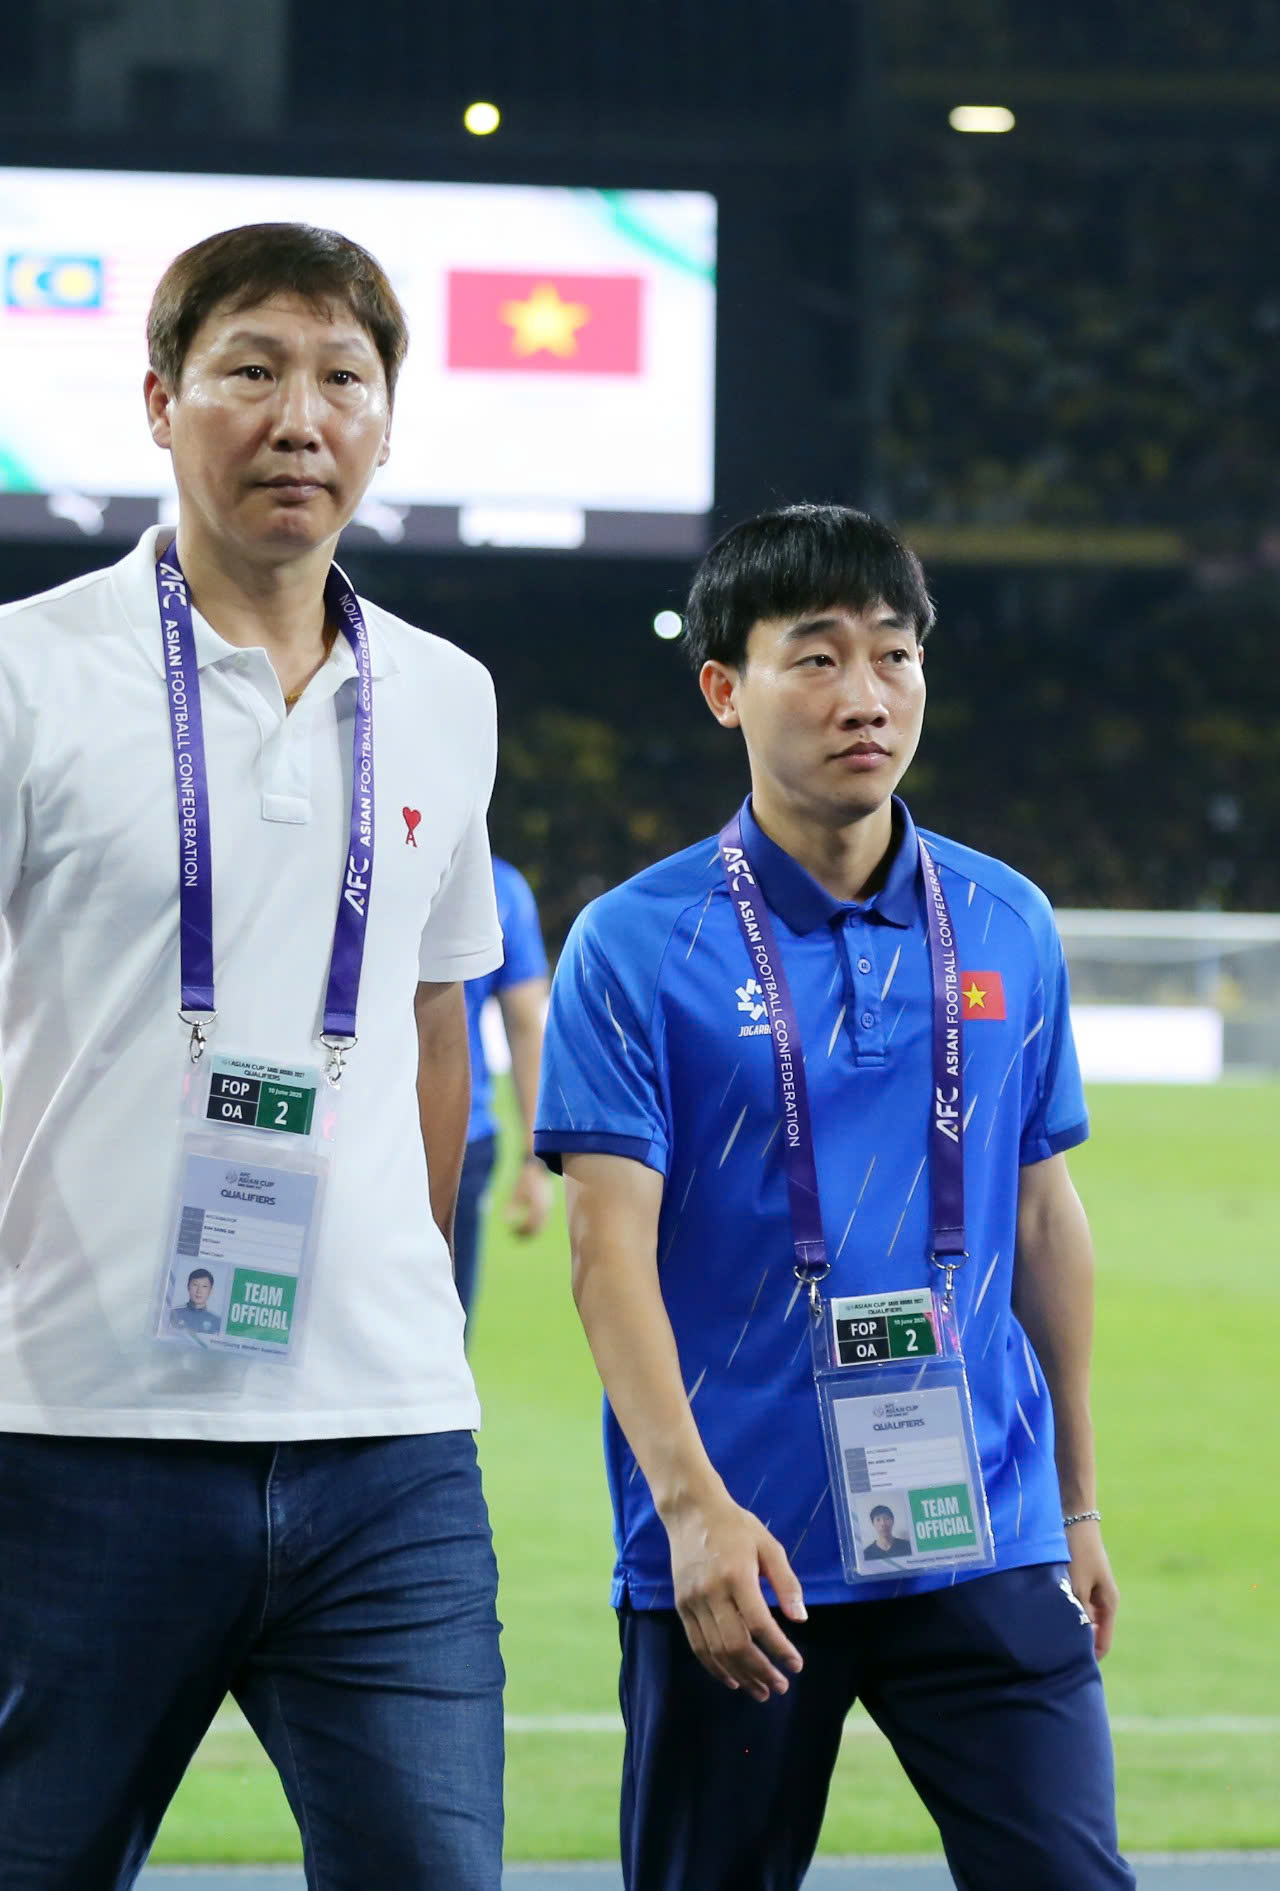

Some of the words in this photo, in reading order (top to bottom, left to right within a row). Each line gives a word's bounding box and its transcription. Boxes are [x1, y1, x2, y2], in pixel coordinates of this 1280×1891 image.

[160, 562, 188, 609] AFC
[165, 620, 182, 667] ASIAN
[339, 593, 371, 712] CONFEDERATION
[171, 671, 190, 749] FOOTBALL
[360, 715, 372, 793] FOOTBALL
[178, 753, 198, 887] CONFEDERATION
[360, 798, 372, 847] ASIAN
[344, 855, 369, 917] AFC
[723, 847, 755, 891] AFC
[738, 900, 762, 943] ASIAN
[753, 944, 783, 1017] FOOTBALL
[944, 949, 959, 1024] FOOTBALL
[738, 1024, 772, 1037] JOGARB
[946, 1028, 959, 1076] ASIAN
[221, 1079, 250, 1096] FOP
[251, 1063, 265, 1071] CUP
[775, 1020, 800, 1147] CONFEDERATION
[221, 1102, 243, 1119] OA
[274, 1101, 289, 1126] 2
[936, 1086, 959, 1143] AFC
[220, 1188, 277, 1206] QUALIFIERS
[244, 1282, 284, 1307] TEAM
[231, 1303, 289, 1330] OFFICIAL
[850, 1321, 878, 1337] FOP
[856, 1343, 878, 1358] OA
[905, 1328, 919, 1352] 2
[873, 1419, 926, 1431] QUALIFIERS
[915, 1515, 973, 1540] OFFICIAL
[921, 1496, 960, 1518] TEAM
